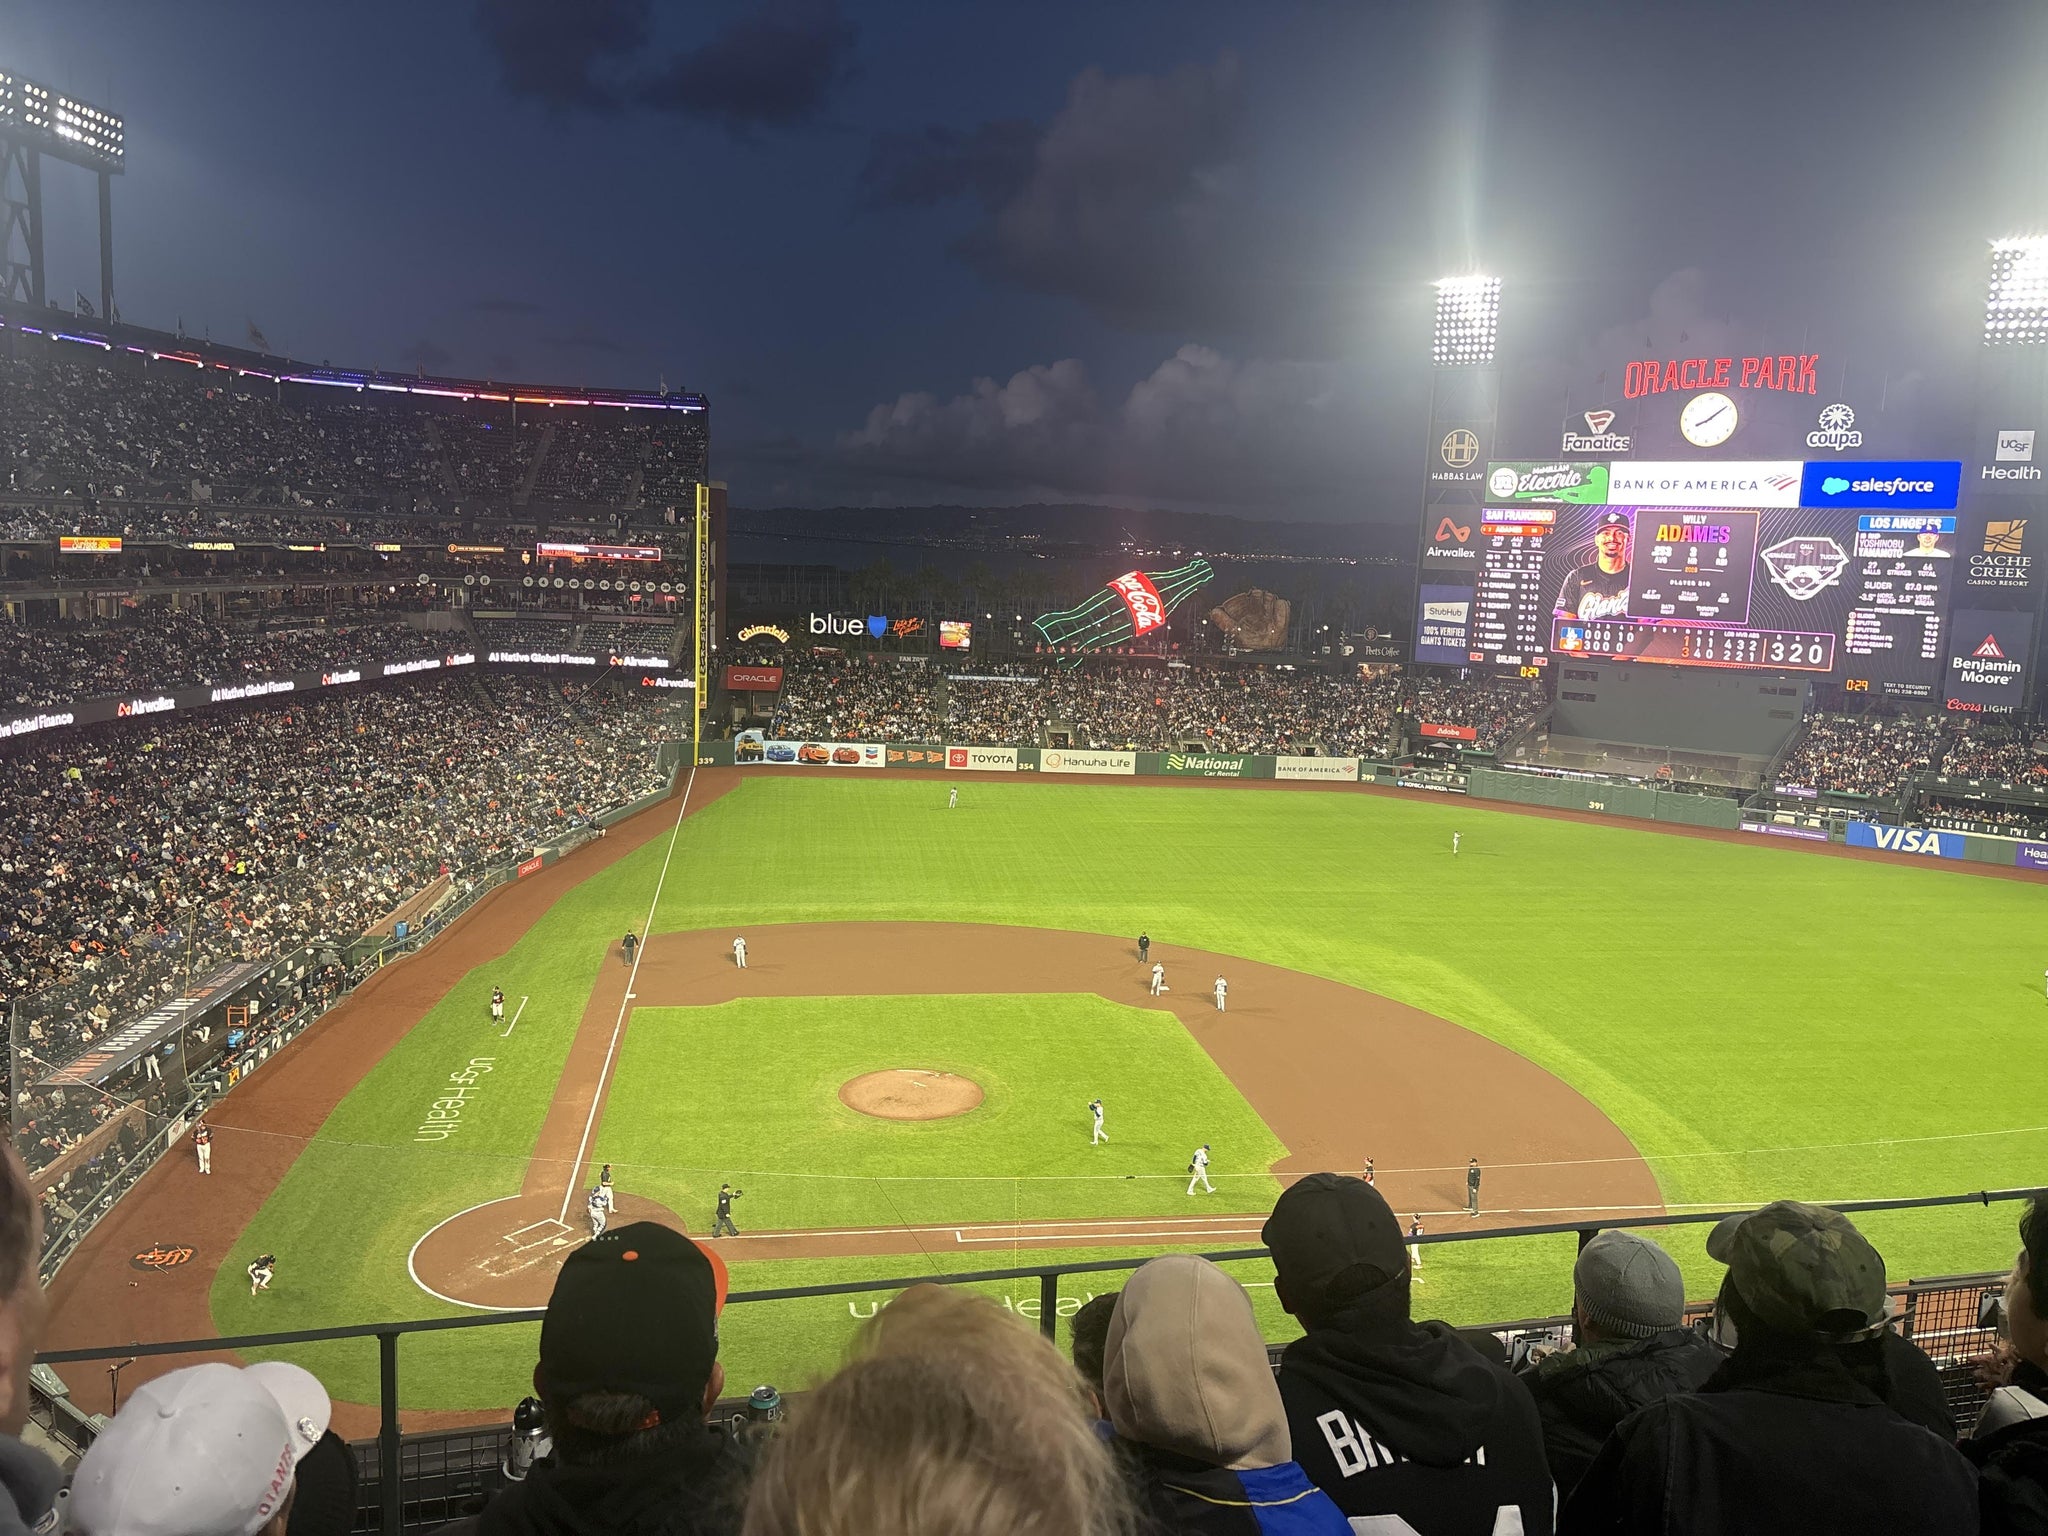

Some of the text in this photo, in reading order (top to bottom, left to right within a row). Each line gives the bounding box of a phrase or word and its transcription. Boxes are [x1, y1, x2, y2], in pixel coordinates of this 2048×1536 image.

[1623, 354, 1819, 399] ORACLE PARK
[1563, 433, 1630, 451] Fanatics
[1808, 431, 1860, 448] coupa
[2001, 439, 2030, 452] UCSF
[1432, 472, 1483, 481] HABBAS LAW
[1982, 466, 2041, 480] Health
[1518, 470, 1581, 492] Electric
[1614, 480, 1758, 490] BANK OF AMERICA
[1852, 478, 1934, 496] salesforce
[1486, 511, 1553, 521] SAN FRANCISCO
[1682, 514, 1707, 524] WILLY
[1870, 518, 1890, 529] LOS
[1656, 524, 1731, 543] ADAMES
[214, 543, 235, 551] MINOLTA
[1860, 539, 1904, 548] YOSHINOBU
[1427, 547, 1475, 558] Airwallex
[1859, 548, 1903, 558] YAMAMOTO
[1868, 561, 1878, 569] 27
[1895, 562, 1905, 570] 39
[1969, 555, 2031, 567] CACHE
[1970, 567, 2028, 579] CREEK
[1864, 581, 1892, 590] SLIDER
[1429, 608, 1462, 616] StubHub
[810, 612, 864, 635] blue
[737, 624, 790, 644] Ghirardelli
[1424, 626, 1465, 637] 100% VERIFIED
[1421, 636, 1466, 648] GIANTS TICKETS
[1585, 630, 1757, 651] 0 0 0 1 0 1 1 1 4 3 2
[1381, 646, 1400, 657] Coffee
[1584, 640, 1754, 662] 3 0 0 0 3 4 0 2 2 1
[1770, 643, 1823, 664] 3 2 0
[488, 652, 595, 665] AI Native Global Finance
[623, 656, 669, 667] Airwallex
[1953, 657, 2021, 673] Benjamin
[331, 670, 360, 685] Airwallex
[733, 674, 777, 682] ORACLE
[1521, 666, 1539, 678] 0:29
[1960, 671, 2009, 685] Moore
[211, 680, 295, 701] AI Native Global Finance
[1846, 679, 1868, 691] 0:29
[132, 696, 175, 715] Airwallex
[1946, 698, 2014, 714] Coors LIGHT
[12, 712, 74, 735] Global Finance
[1437, 727, 1460, 737] Adobe
[972, 754, 1014, 764] TOYOTA
[1063, 757, 1131, 768] Hanwha Life
[1185, 757, 1244, 771] National
[1361, 773, 1375, 782] 399
[1404, 781, 1448, 793] KONICA MINOLTA
[1588, 800, 1605, 810] 391
[1924, 818, 1975, 831] WELCOME
[1986, 825, 1998, 834] TO
[2009, 827, 2028, 837] THE
[1869, 825, 1941, 855] VISA
[521, 860, 540, 874] ORACLE
[160, 998, 201, 1011] SAN
[97, 1012, 180, 1051] FRANCISCO
[414, 1058, 496, 1141] UCSF Health
